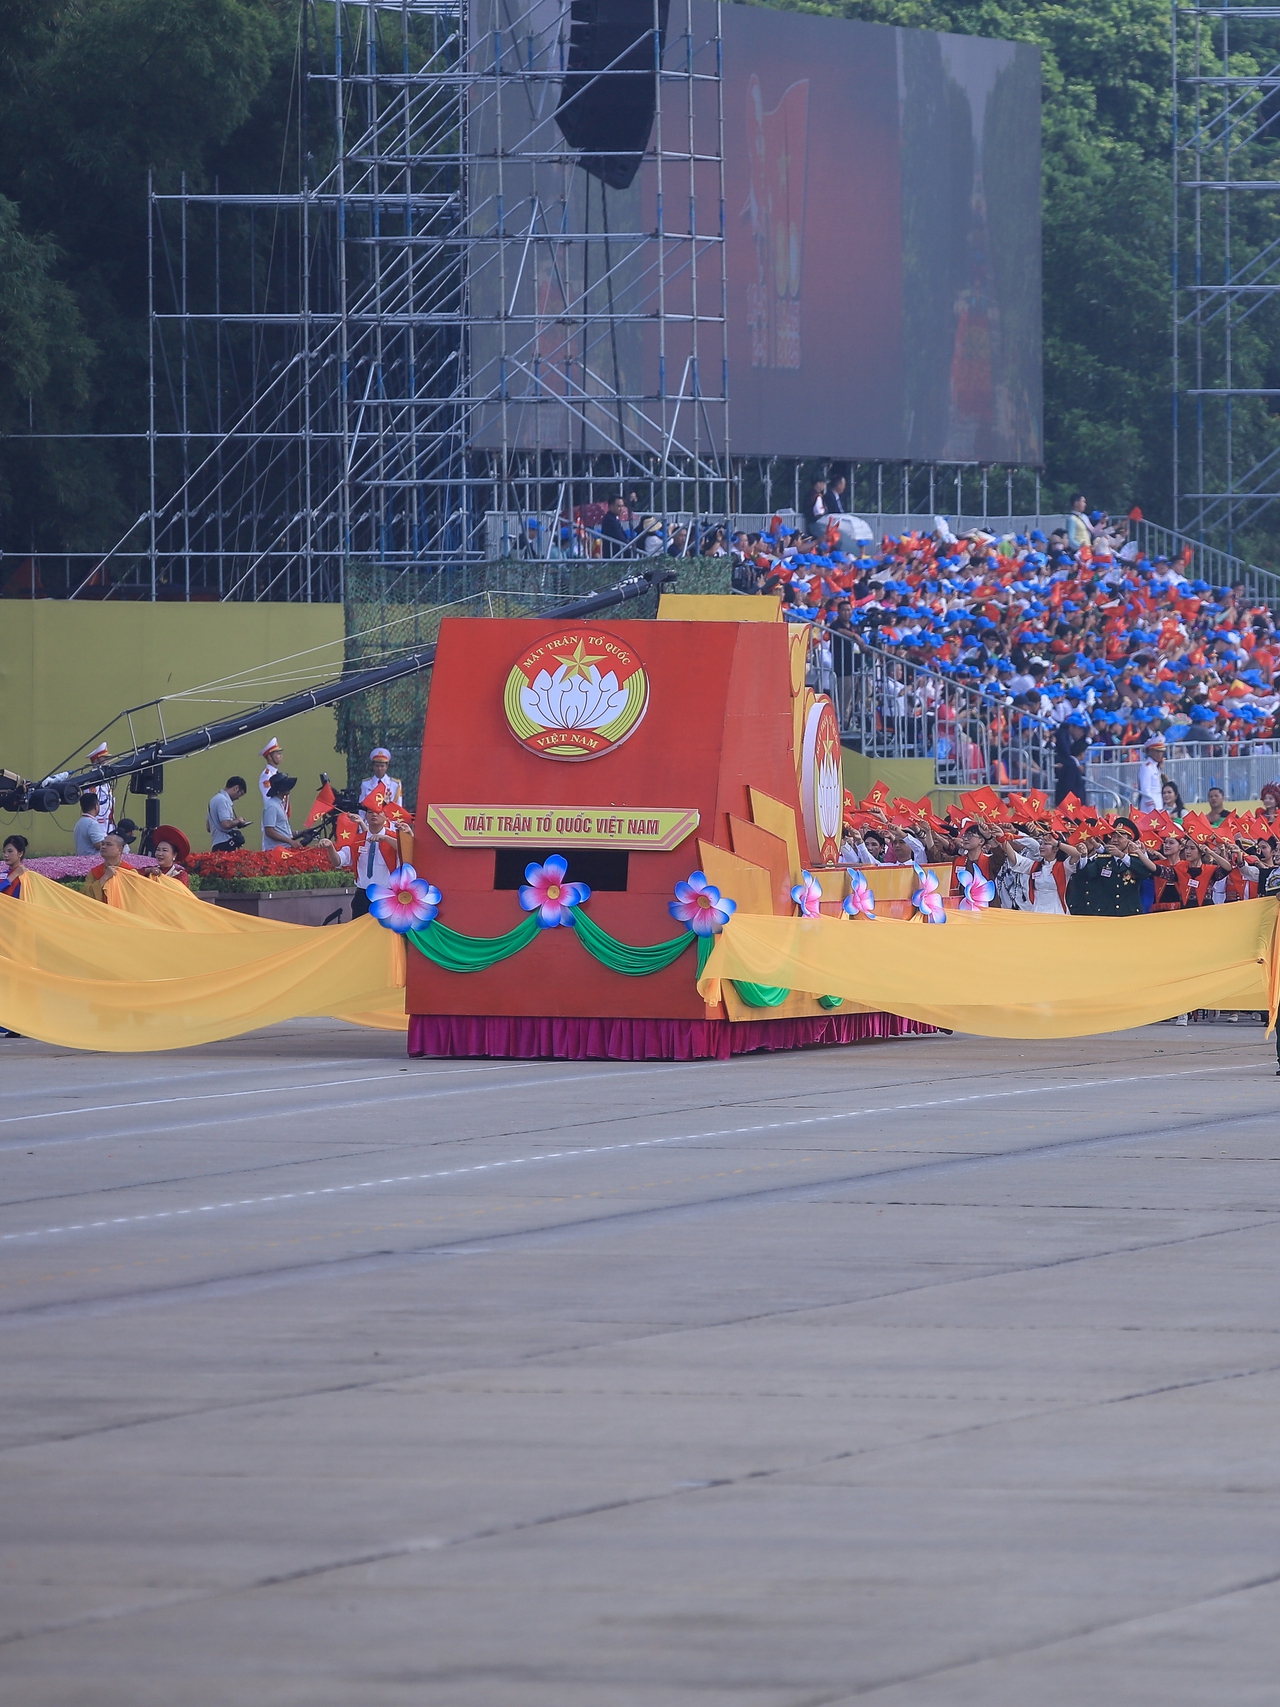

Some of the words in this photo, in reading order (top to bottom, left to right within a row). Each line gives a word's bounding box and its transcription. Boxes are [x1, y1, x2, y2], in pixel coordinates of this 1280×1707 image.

[522, 647, 544, 668] MẶT
[546, 635, 579, 651] TRẬN
[588, 635, 606, 646] TỔ
[604, 643, 631, 666] QUỐC
[536, 732, 568, 747] VIỆT
[570, 733, 599, 749] NAM
[464, 812, 494, 835] MẶT
[497, 812, 532, 836] TRẬN
[536, 811, 554, 833] TỔ
[555, 812, 593, 834] QUỐC
[596, 815, 625, 838] VIỆT
[627, 818, 660, 835] NAM
